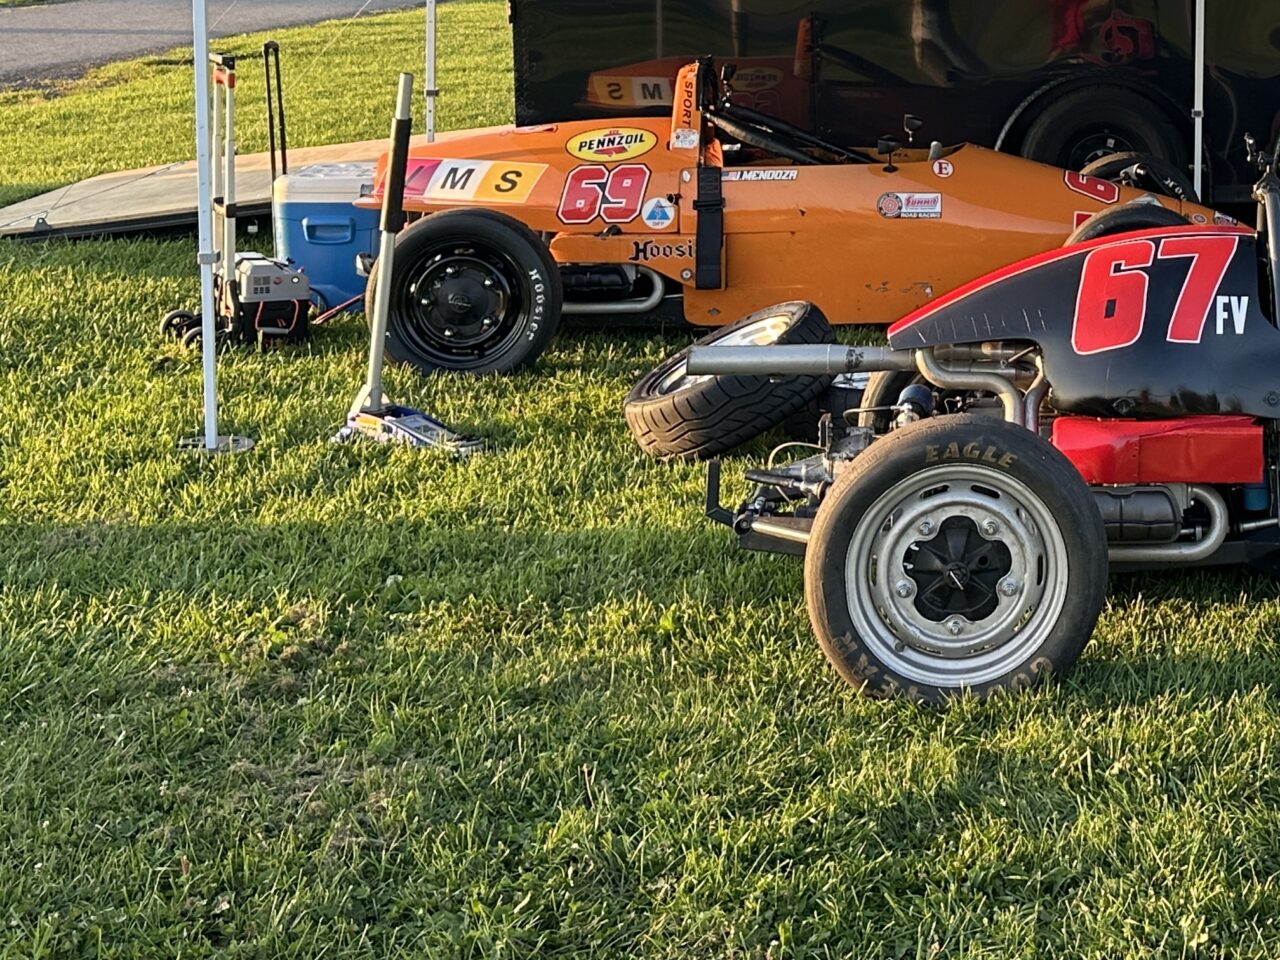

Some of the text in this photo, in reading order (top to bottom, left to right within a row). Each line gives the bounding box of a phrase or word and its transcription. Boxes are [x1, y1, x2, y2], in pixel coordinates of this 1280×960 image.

[682, 81, 694, 129] SPORT
[578, 133, 646, 152] PENNZOIL
[732, 169, 798, 181] J.MENDOZA
[557, 163, 652, 224] 69
[629, 240, 693, 261] Hoosi
[1071, 235, 1249, 356] 67 FV
[925, 441, 1019, 469] EAGLE
